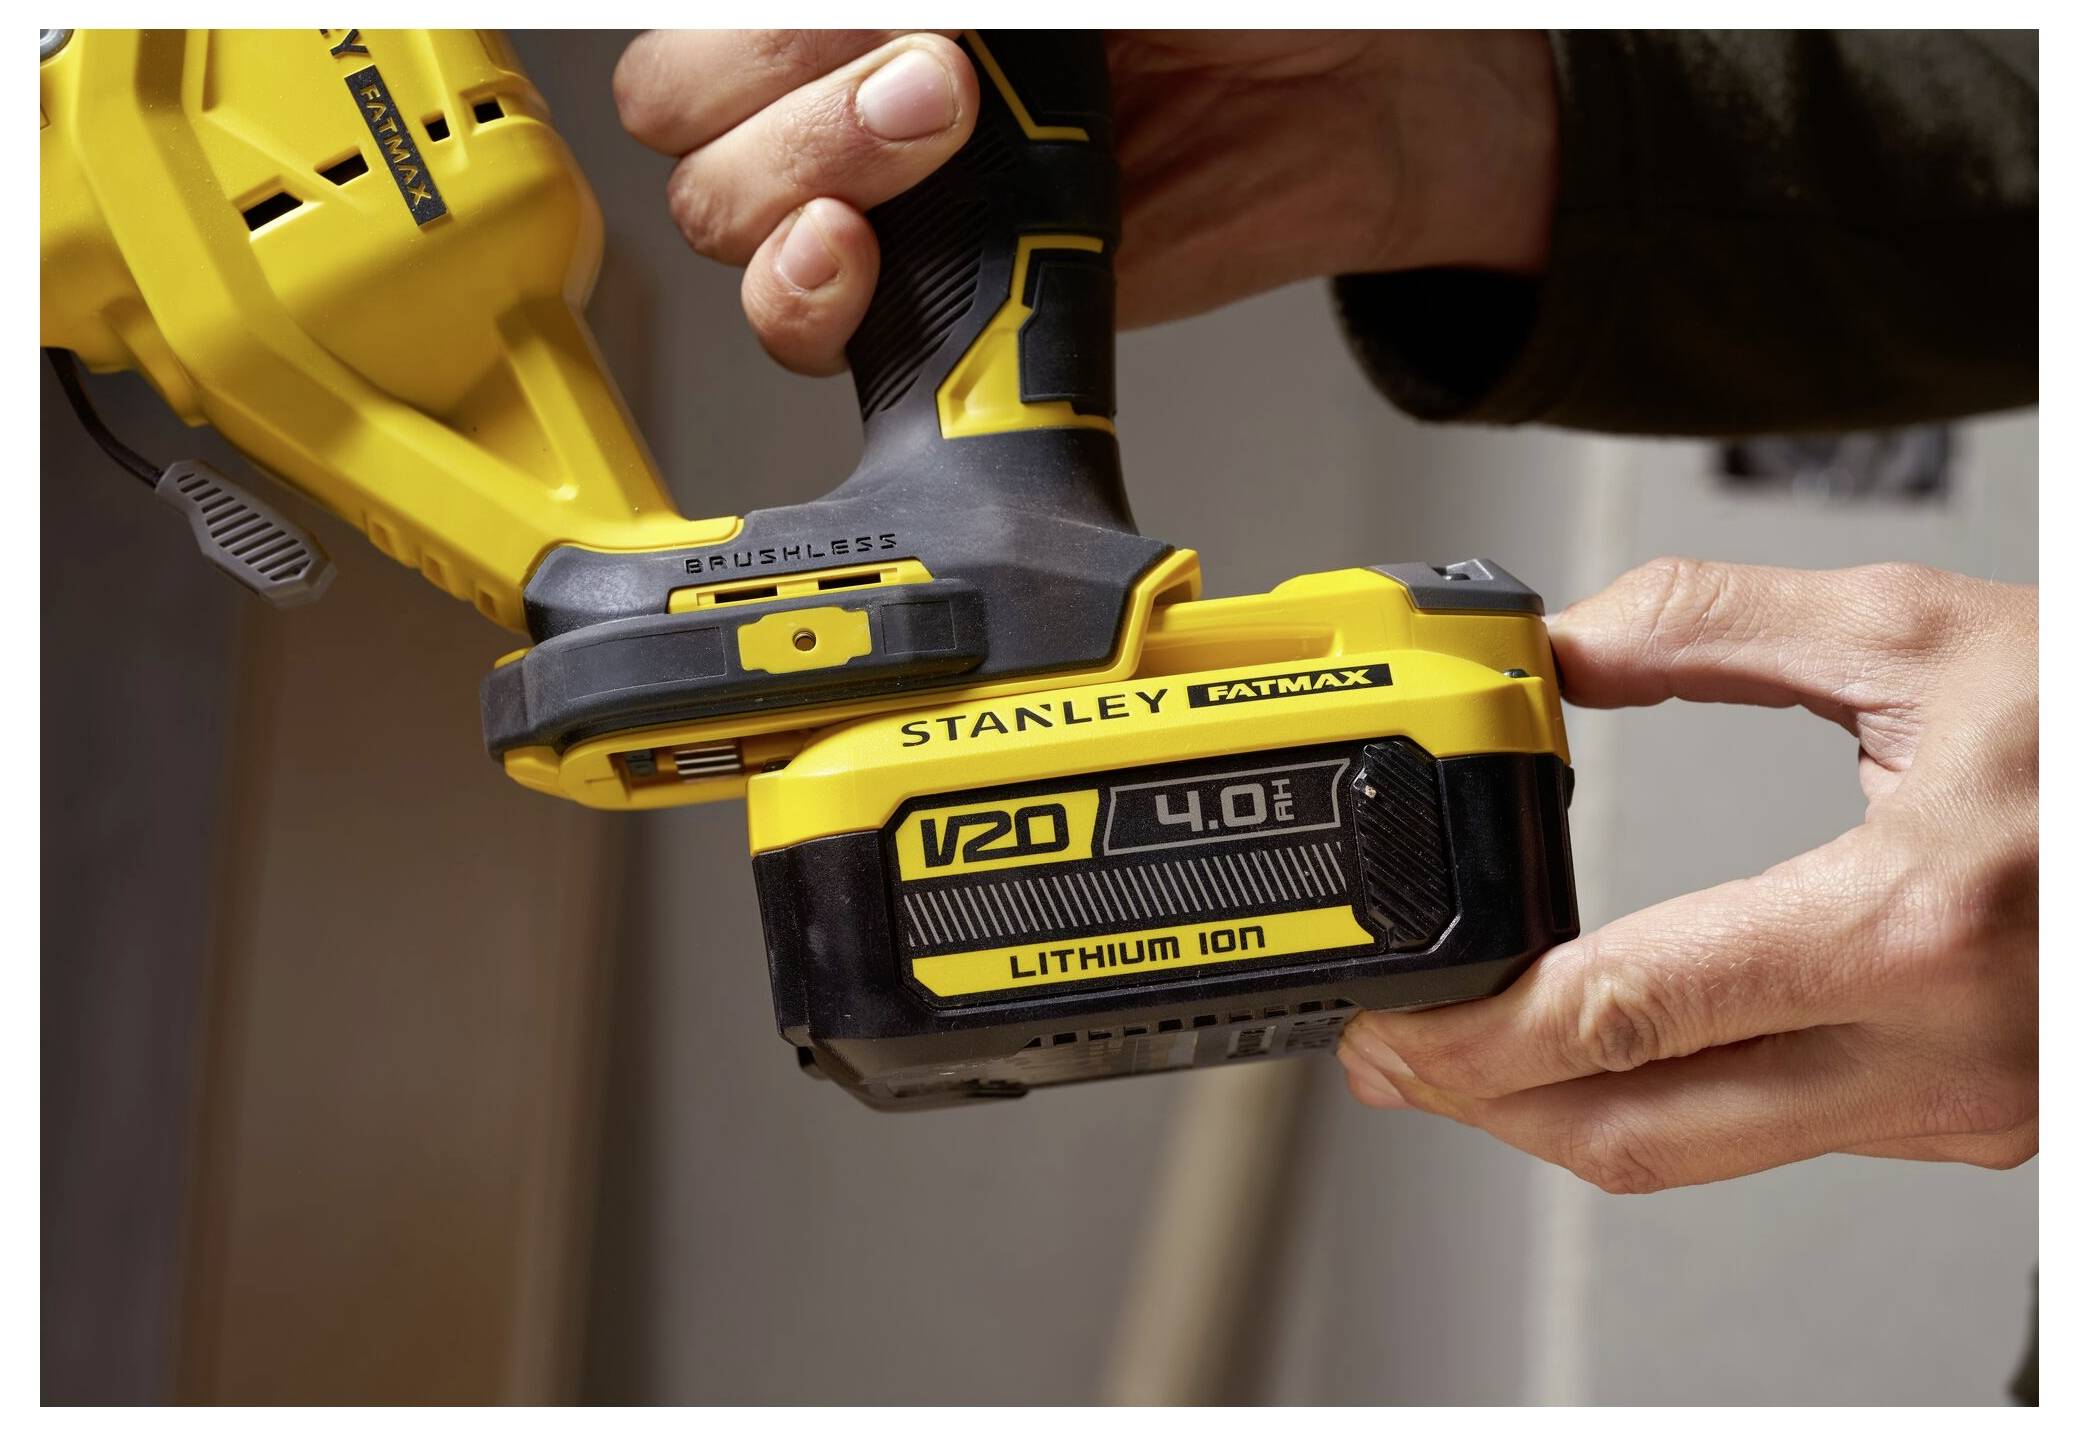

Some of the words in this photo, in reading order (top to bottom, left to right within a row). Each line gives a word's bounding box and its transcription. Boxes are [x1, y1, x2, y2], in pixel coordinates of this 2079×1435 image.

[319, 29, 369, 56] Y
[360, 84, 431, 205] FATMAX
[686, 533, 898, 574] BRUSHLESS
[902, 688, 1168, 748] STANLEY
[1208, 668, 1373, 702] FATMAX
[921, 804, 1069, 868] V20
[1155, 783, 1267, 833] 4.0
[1010, 935, 1180, 979] LITHIUM
[1199, 924, 1266, 955] ION
